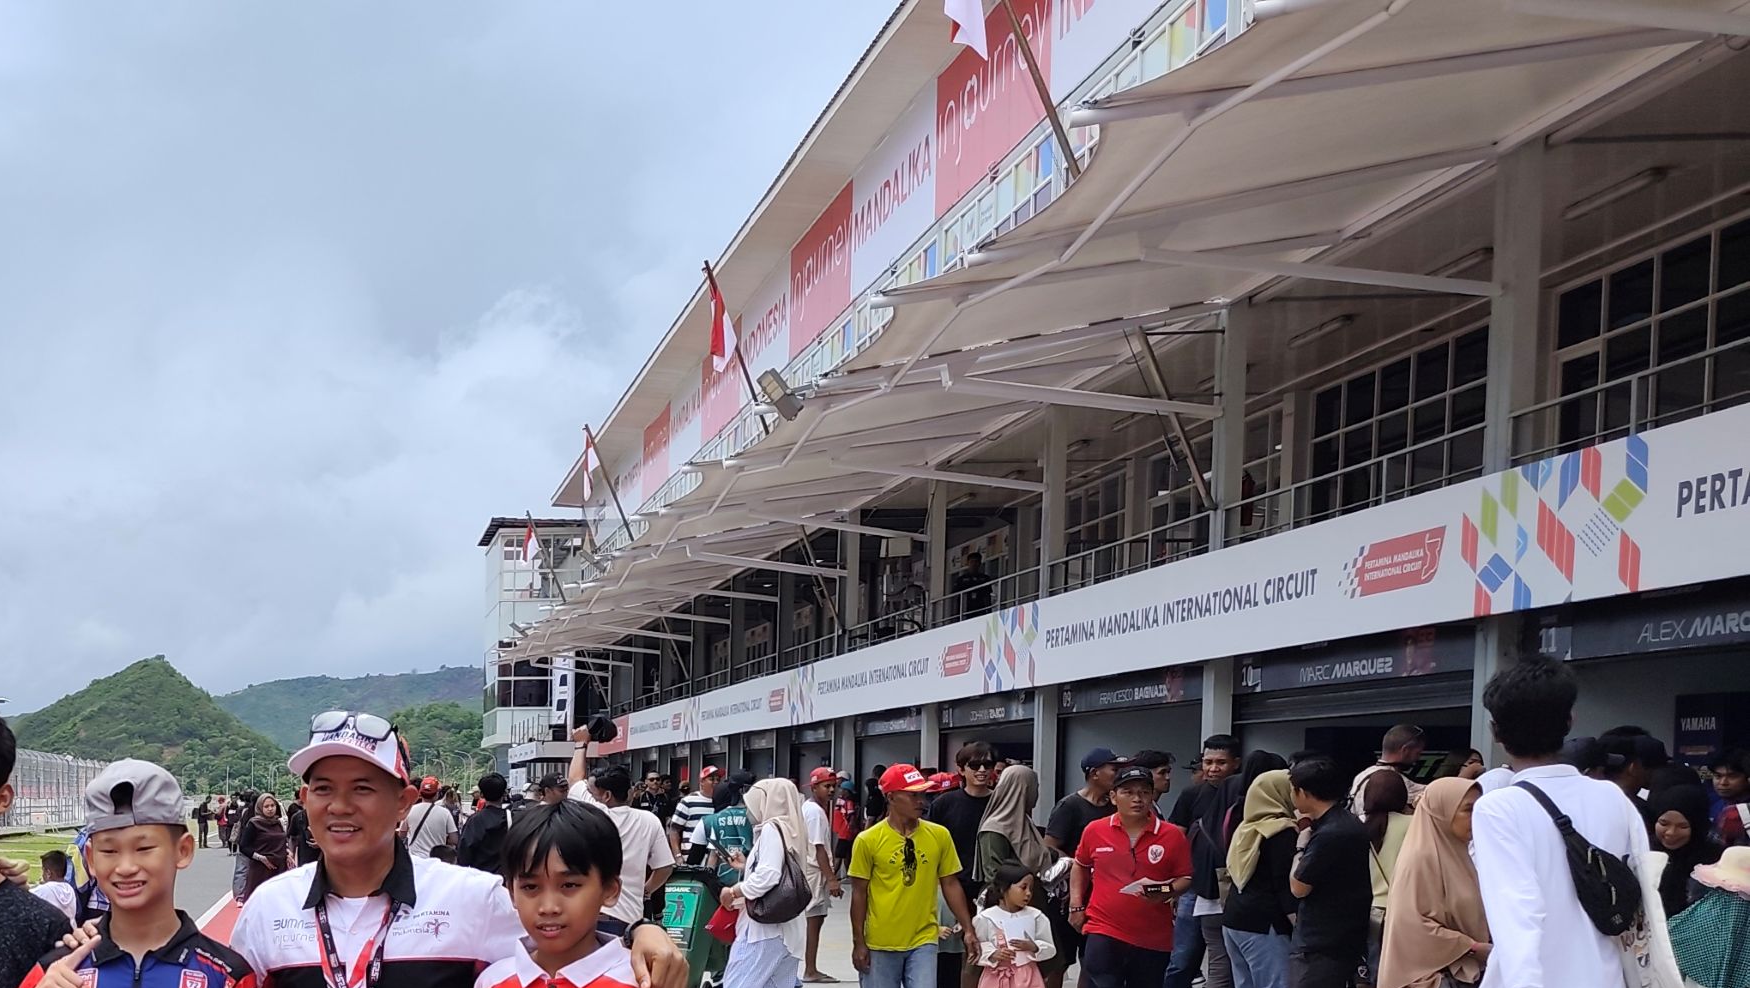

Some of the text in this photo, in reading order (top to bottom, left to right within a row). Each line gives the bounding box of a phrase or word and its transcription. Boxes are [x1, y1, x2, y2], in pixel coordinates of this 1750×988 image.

[853, 134, 931, 253] MANDALIKA
[1045, 568, 1318, 649] PERTAMINA MANDALIKA INTERNATIONAL CIRCUIT
[1539, 627, 1558, 654] 11
[1637, 619, 1687, 645] ALEX
[868, 662, 908, 686] INTERNATIONAL
[908, 657, 930, 676] CIRCUIT
[1299, 656, 1393, 683] MARC MARQUEZ
[1133, 684, 1169, 701] BAGNAIA
[1680, 716, 1716, 731] YAMAHA
